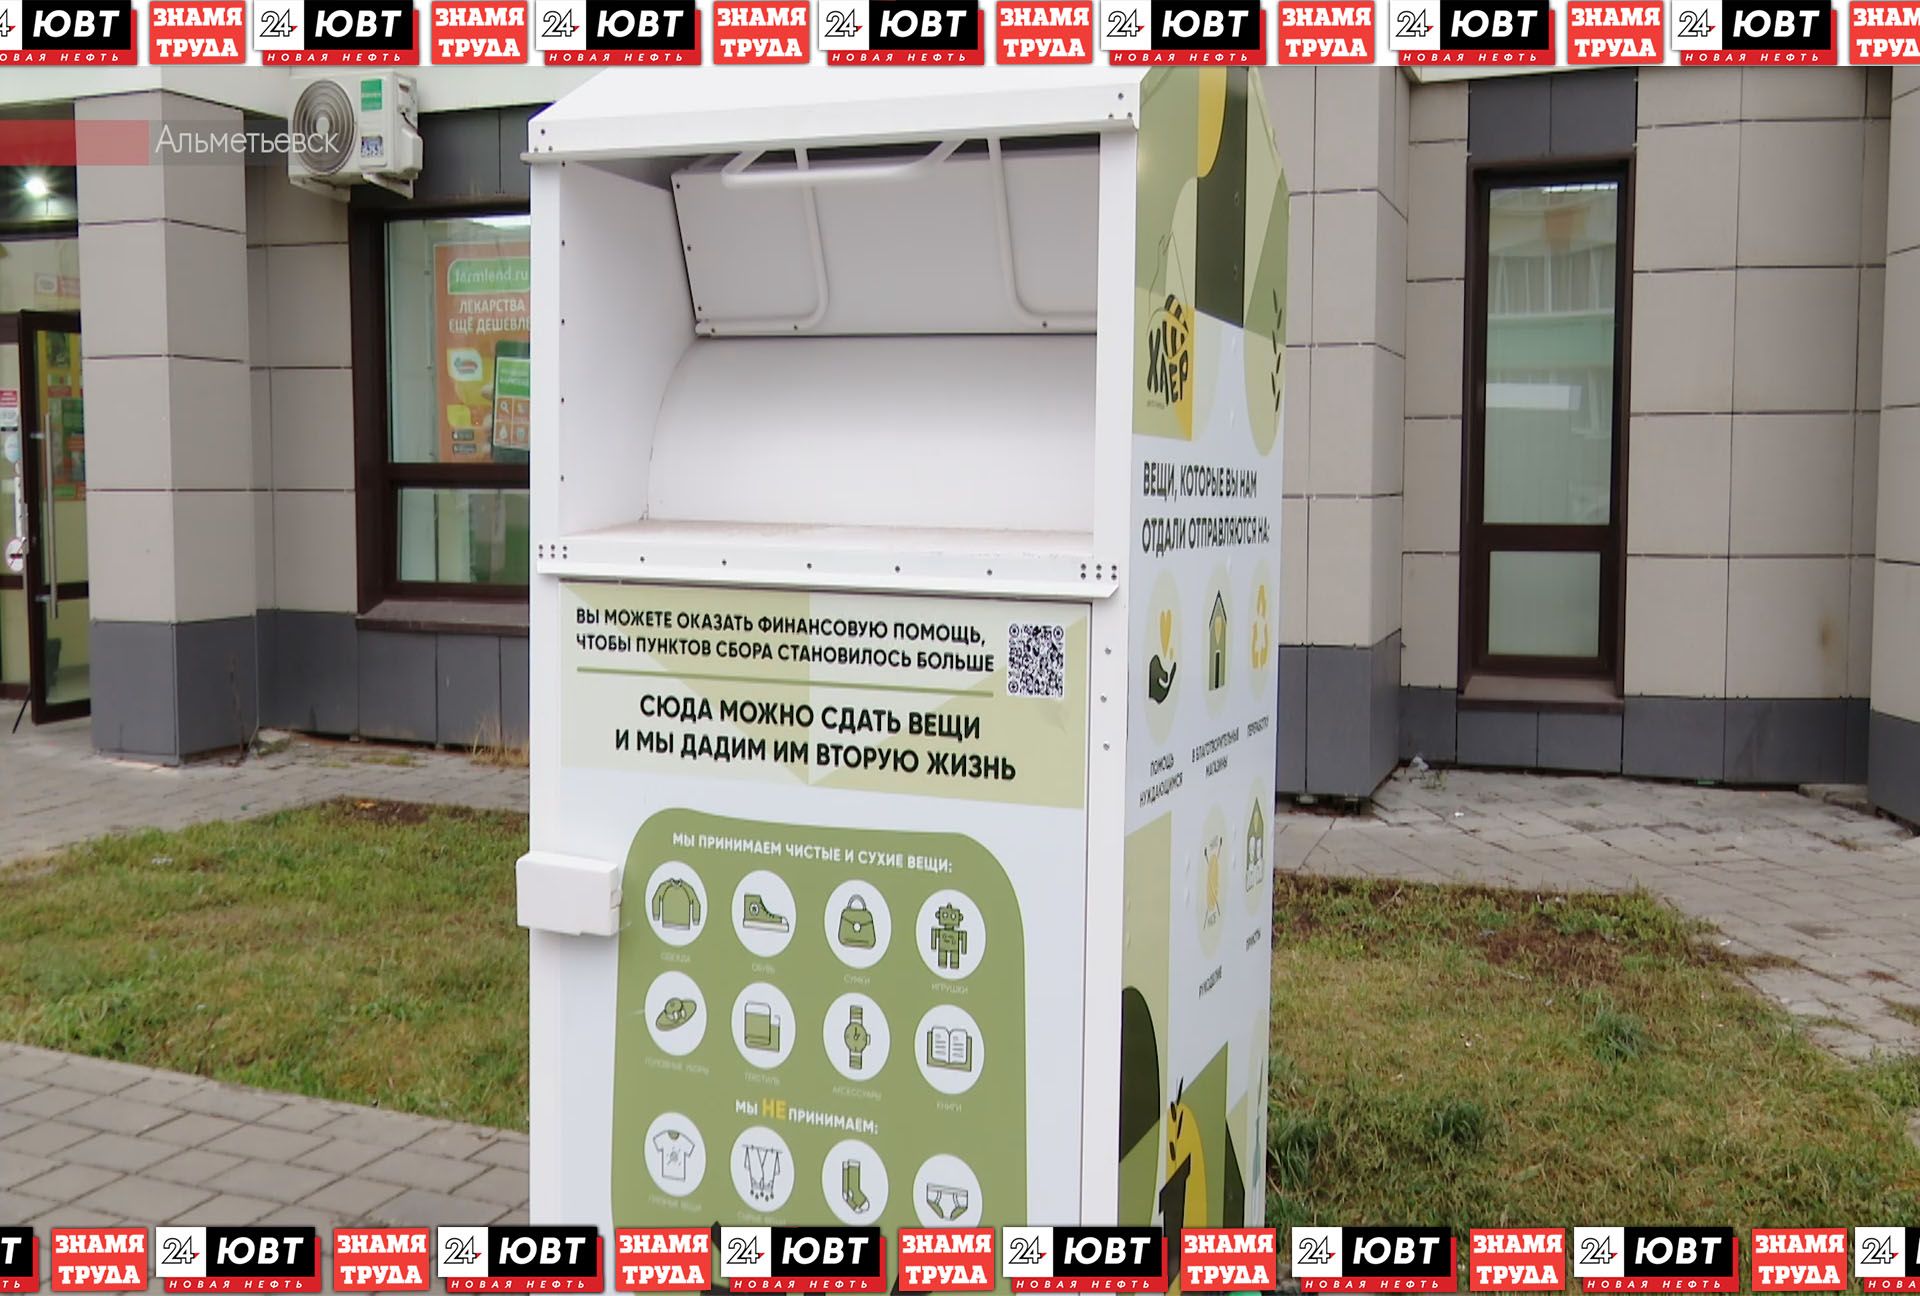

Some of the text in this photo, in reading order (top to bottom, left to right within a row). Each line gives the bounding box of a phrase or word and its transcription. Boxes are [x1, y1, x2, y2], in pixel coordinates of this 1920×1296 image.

[449, 316, 474, 335] ЕЩЁ
[459, 298, 526, 314] ЛЕКАРСТВА
[1143, 461, 1257, 502] ВЕЩИ, КОТОРЫЕ ВЫ НАМ
[1142, 517, 1186, 558] ОТДАЛИ
[1188, 516, 1257, 549] ОТПРАВЛЯЮТСЯ
[576, 608, 986, 648] ВЫ МОЖЕТЕ ОКАЗАТЬ ФИНАНСОВУЮ ПОМОЩЬ,
[576, 634, 995, 673] ЧТОБЫ ПУНКТОВ СБОРА СТАНОВИЛОСЬ БОЛЬШЕ
[639, 694, 981, 744] СЮДА МОЖНО СДАТЬ ВЕЩИ
[615, 728, 1017, 781] И МЫ ДАДИМ ИМ ВТОРУЮ ЖИЗНЬ
[672, 832, 954, 874] МЫ ПРИНИМАЕМ ЧИСТЫЕ И СУХИЕ ВЕЩИ:
[735, 1097, 879, 1136] МЫ НЕ ПРИНИМАЕМ:
